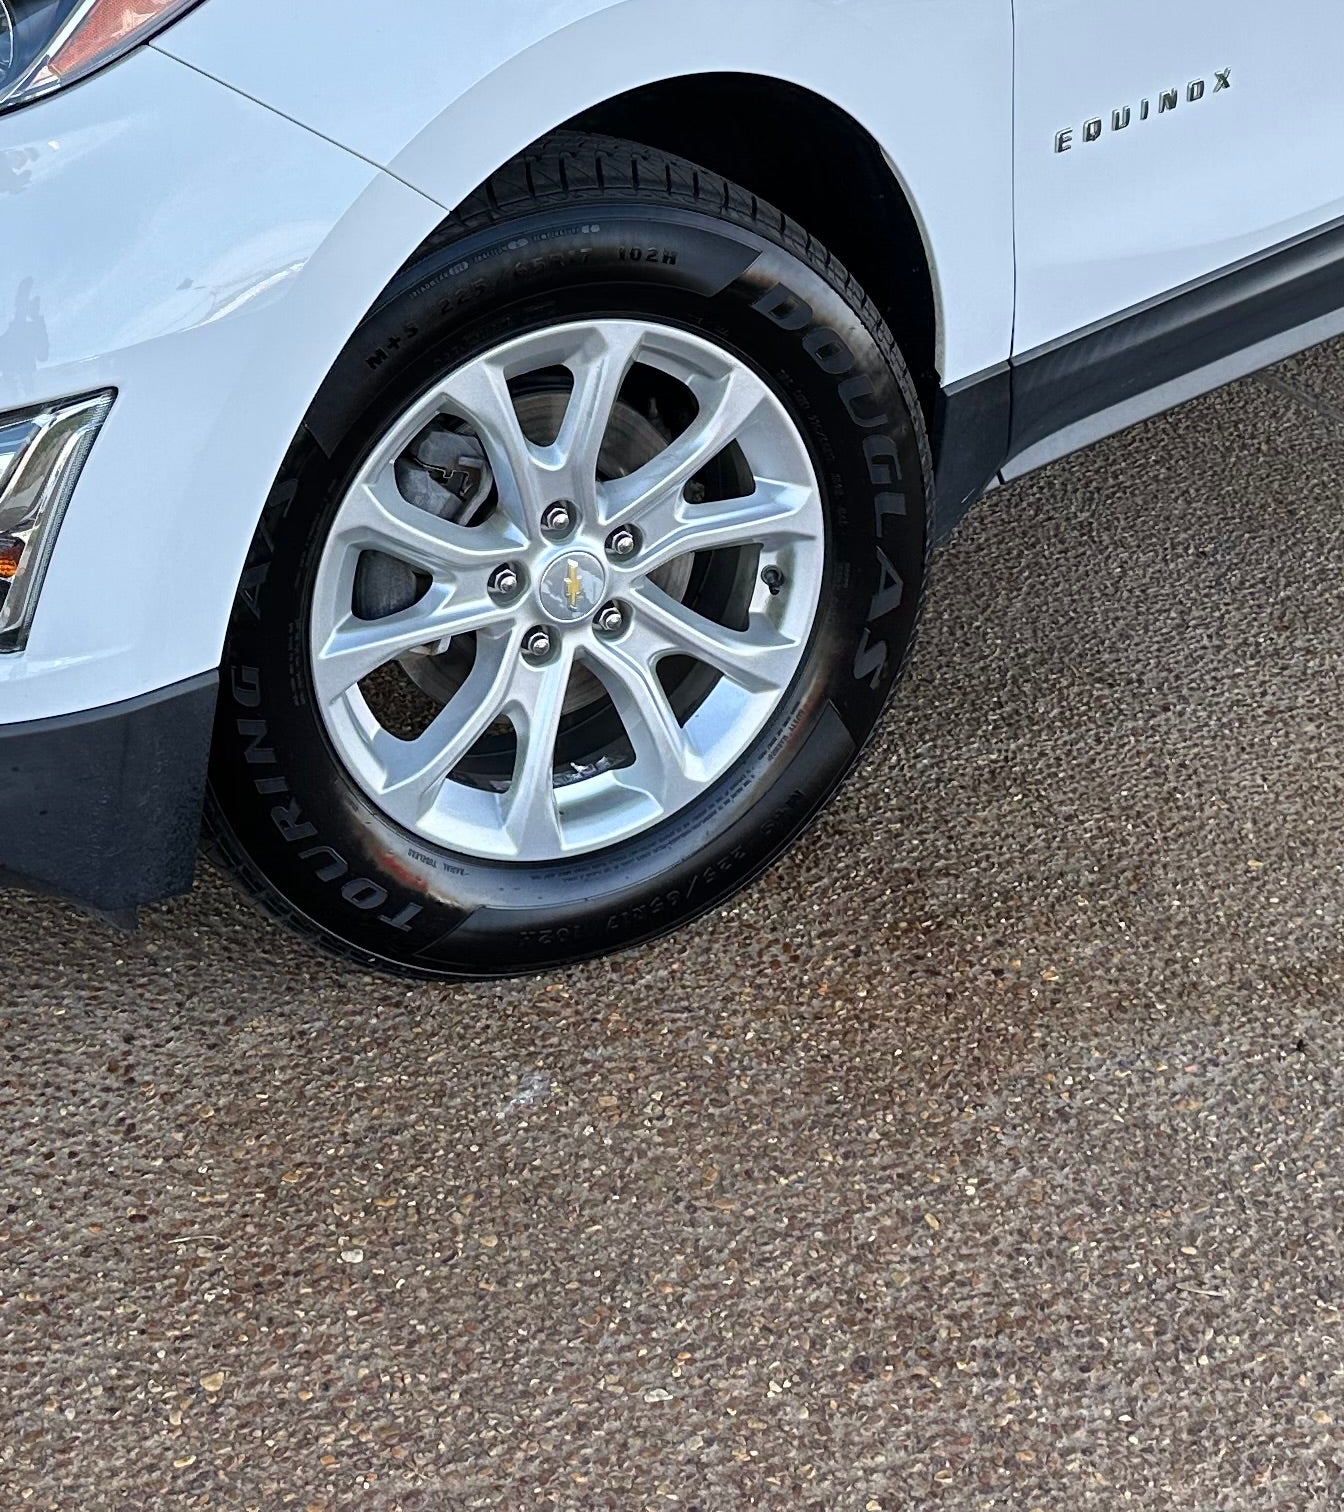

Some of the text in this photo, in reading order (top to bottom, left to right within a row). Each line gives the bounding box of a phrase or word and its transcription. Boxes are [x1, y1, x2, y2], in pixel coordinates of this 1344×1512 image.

[1054, 67, 1232, 153] EQUINOX
[365, 322, 419, 370] M+S
[618, 247, 678, 265] 102H
[752, 282, 906, 690] DOUGLAS
[232, 666, 424, 933] TOURING
